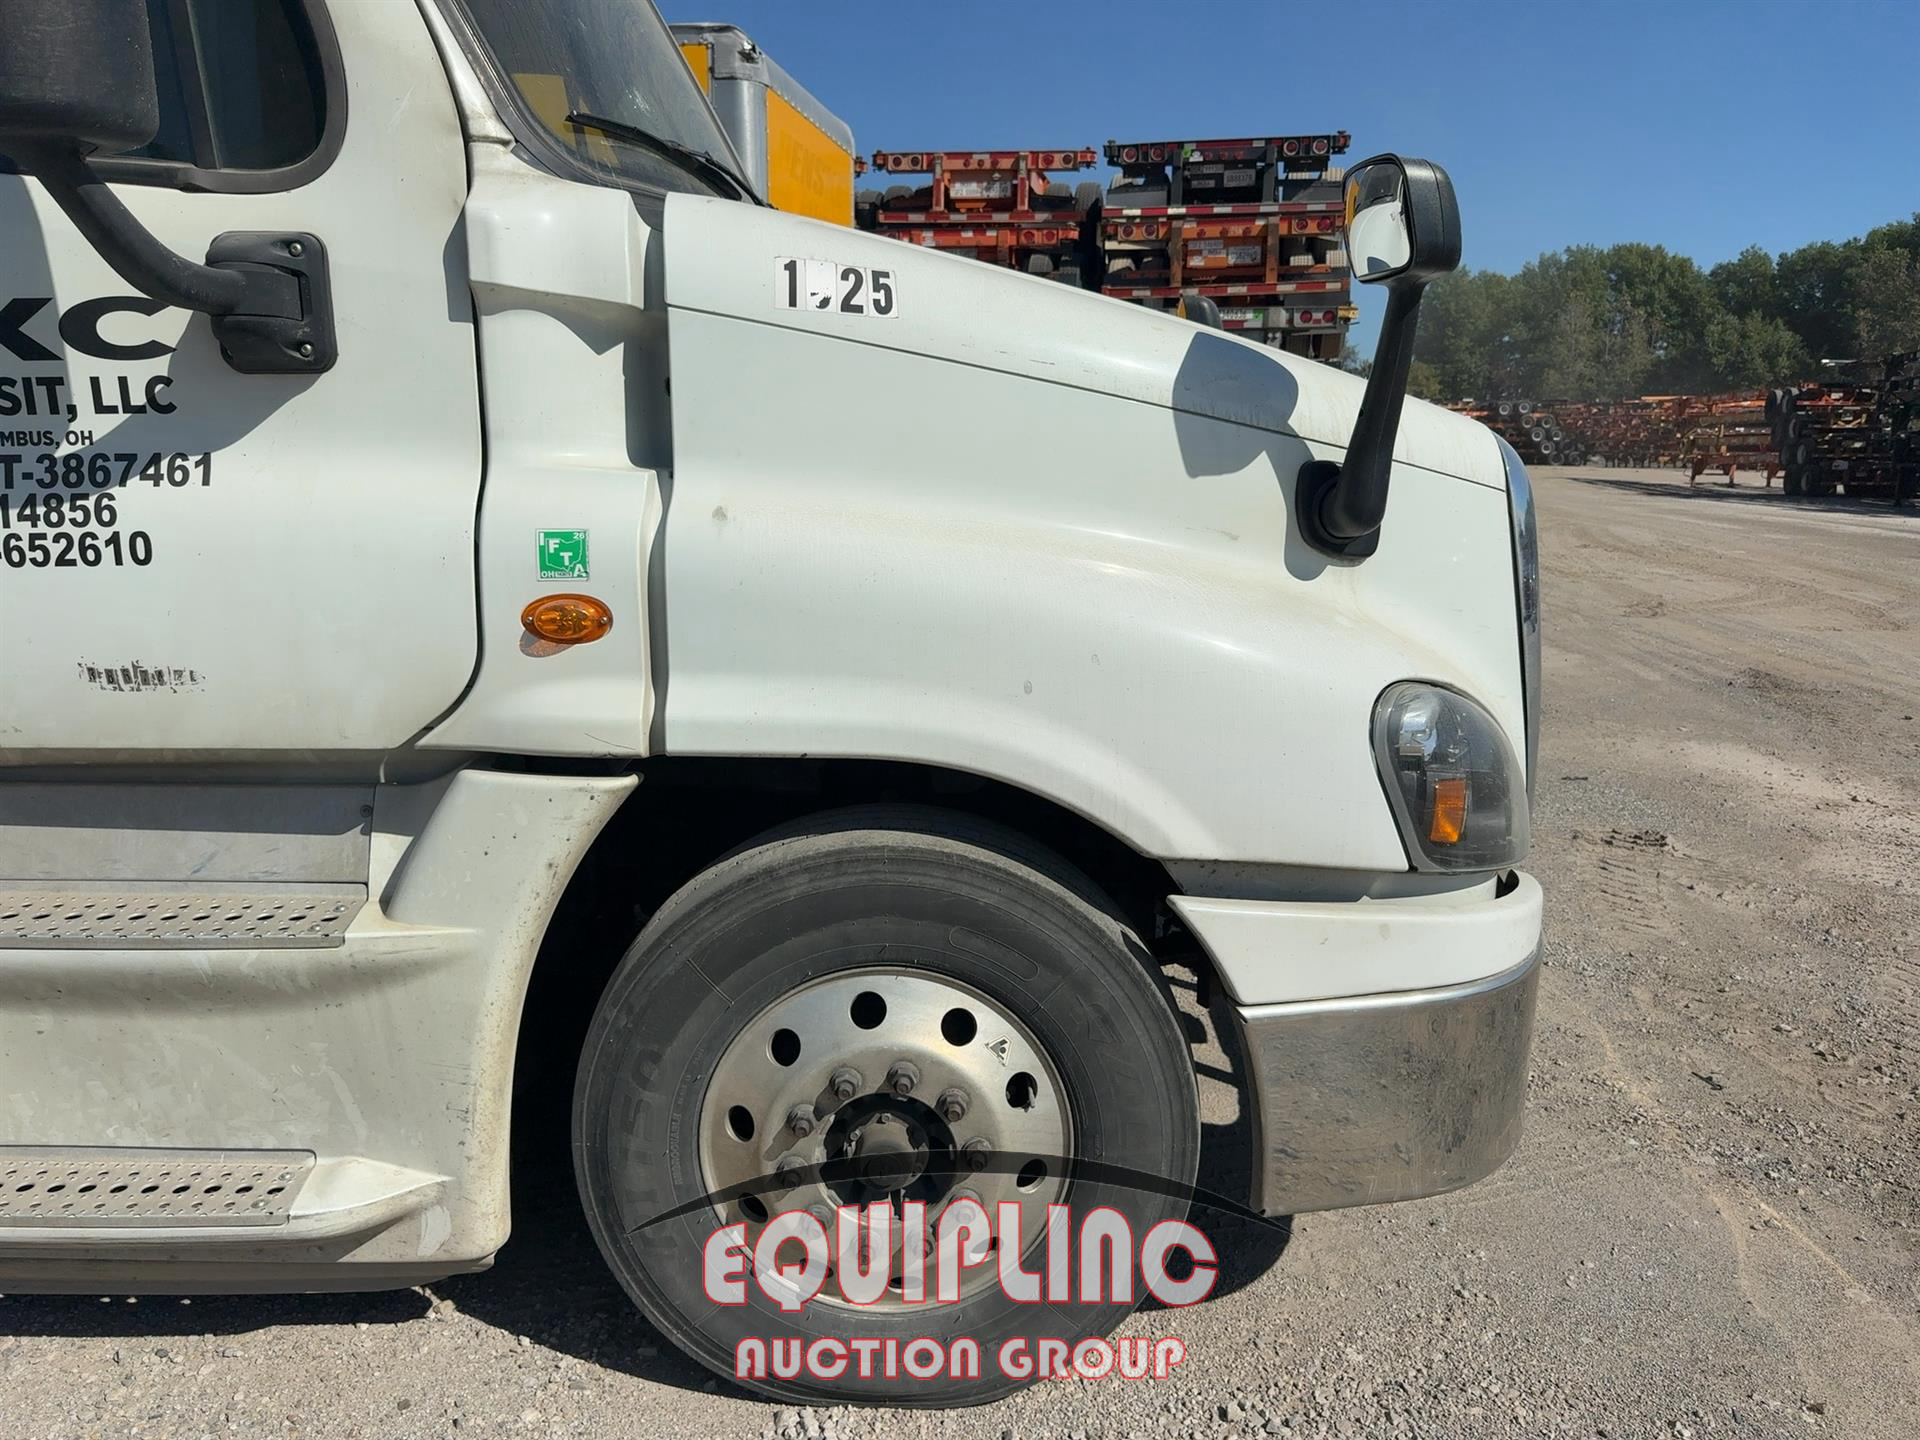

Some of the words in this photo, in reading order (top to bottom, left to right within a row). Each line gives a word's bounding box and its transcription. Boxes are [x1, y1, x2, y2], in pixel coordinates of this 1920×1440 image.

[784, 259, 893, 315] 125
[0, 376, 78, 423] SIT,
[89, 375, 177, 415] LLC
[0, 430, 60, 449] MBUS,
[65, 430, 94, 446] OH
[0, 452, 211, 489] T-3867461
[0, 492, 117, 529] 14856
[0, 531, 153, 568] 652610
